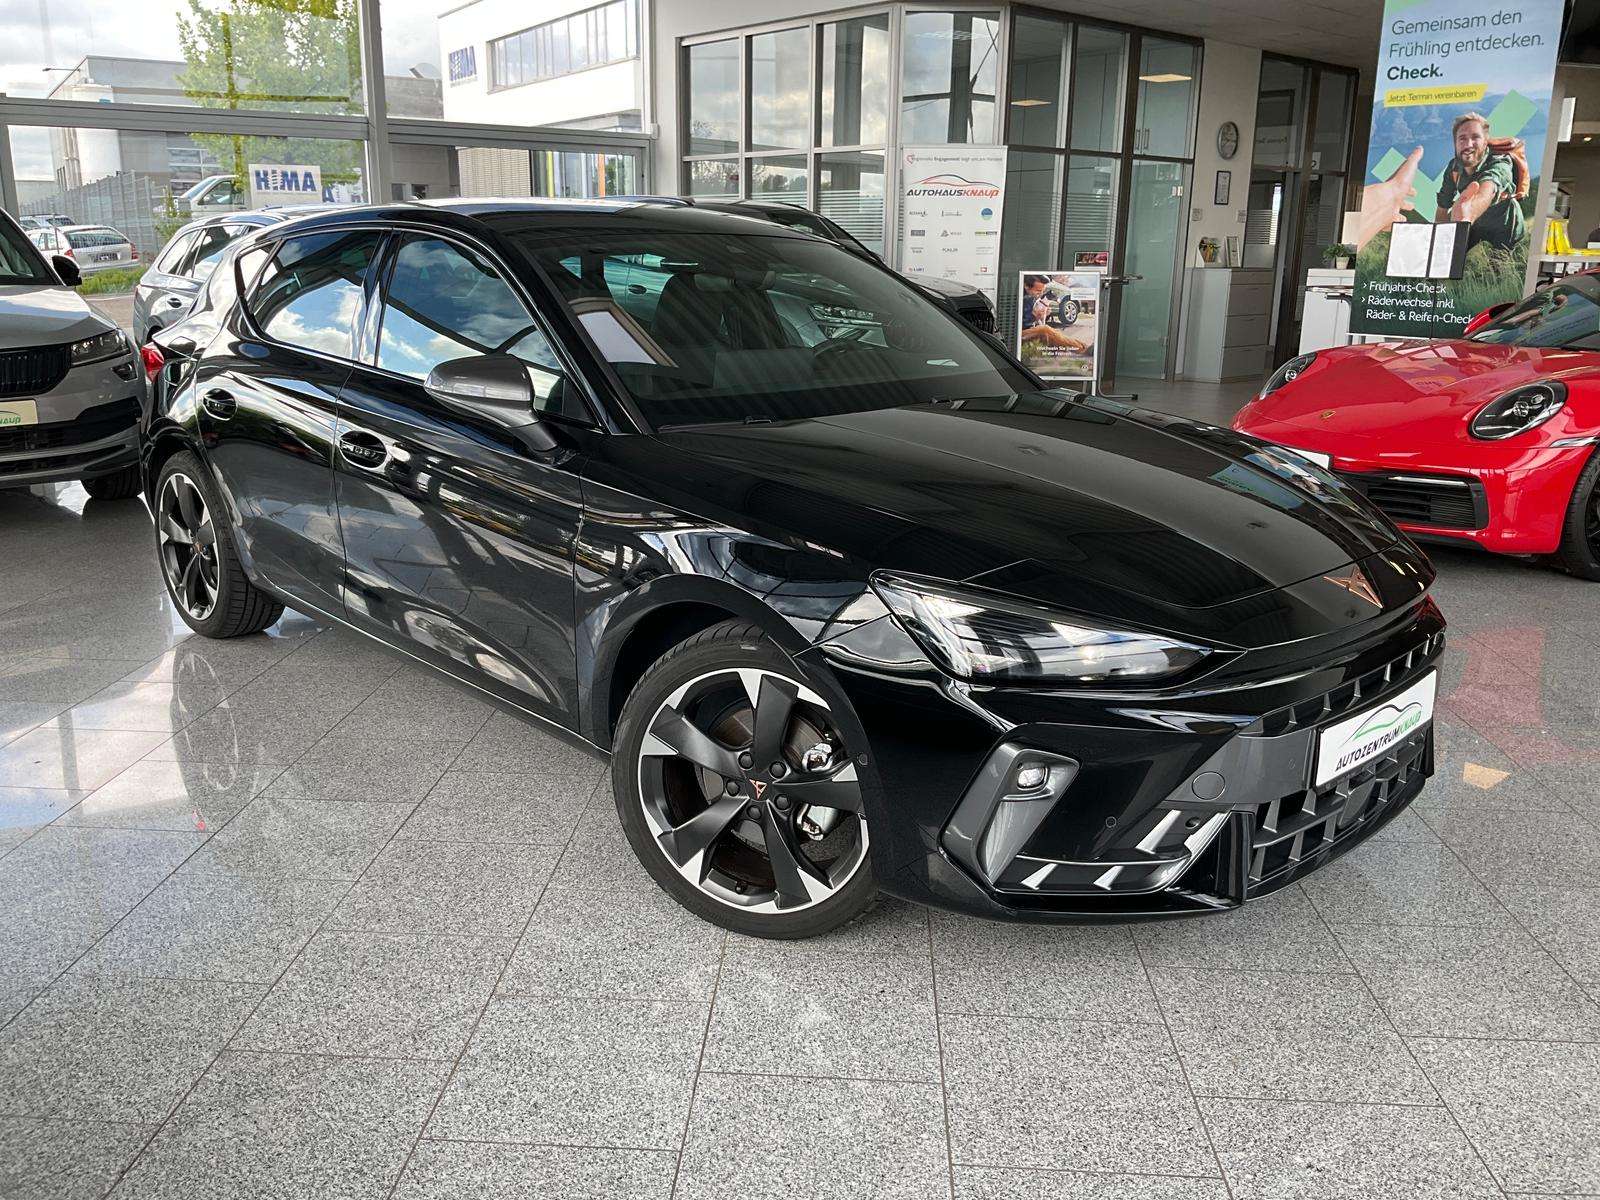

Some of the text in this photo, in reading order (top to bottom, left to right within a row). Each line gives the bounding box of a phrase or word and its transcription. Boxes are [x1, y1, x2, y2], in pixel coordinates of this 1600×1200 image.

[1391, 10, 1522, 36] Gemeinsam den
[1389, 33, 1545, 58] Frühling entdecken.
[1387, 63, 1443, 81] Check.
[1388, 90, 1477, 102] Jetzt Termin vereinbaren
[254, 169, 317, 192] HIMA
[1436, 298, 1455, 308] inkl.
[1366, 309, 1396, 320] Räder-
[1398, 311, 1406, 320] &
